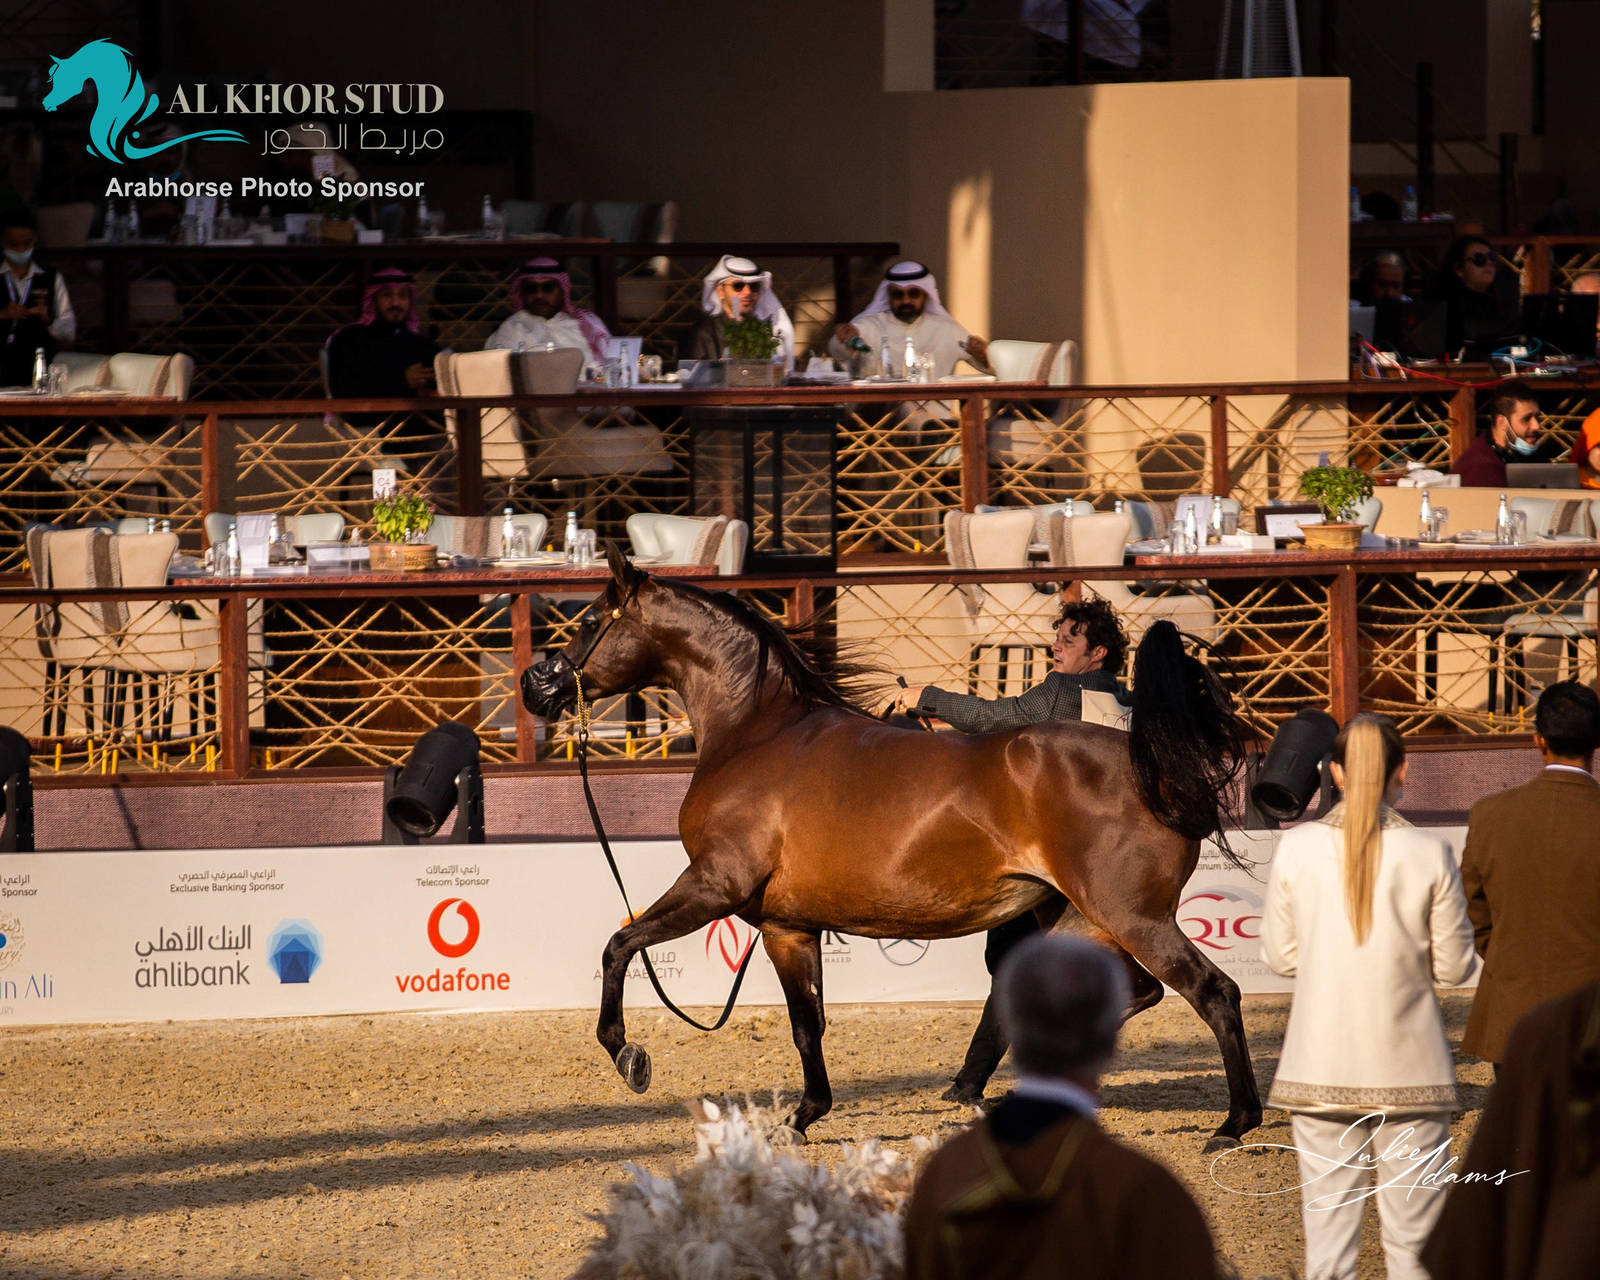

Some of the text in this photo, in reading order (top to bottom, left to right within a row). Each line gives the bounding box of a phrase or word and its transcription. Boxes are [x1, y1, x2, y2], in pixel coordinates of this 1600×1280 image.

[2, 887, 38, 899] Sponsor
[169, 882, 284, 893] Exclusive Banking Sponsor
[415, 877, 490, 887] Telecom Sponsor
[135, 924, 251, 963] البنك الأهلي
[1181, 915, 1264, 951] QIC
[25, 973, 54, 999] Ali
[135, 960, 251, 988] ahlibank
[395, 967, 511, 993] vodafone
[655, 967, 684, 979] CITY
